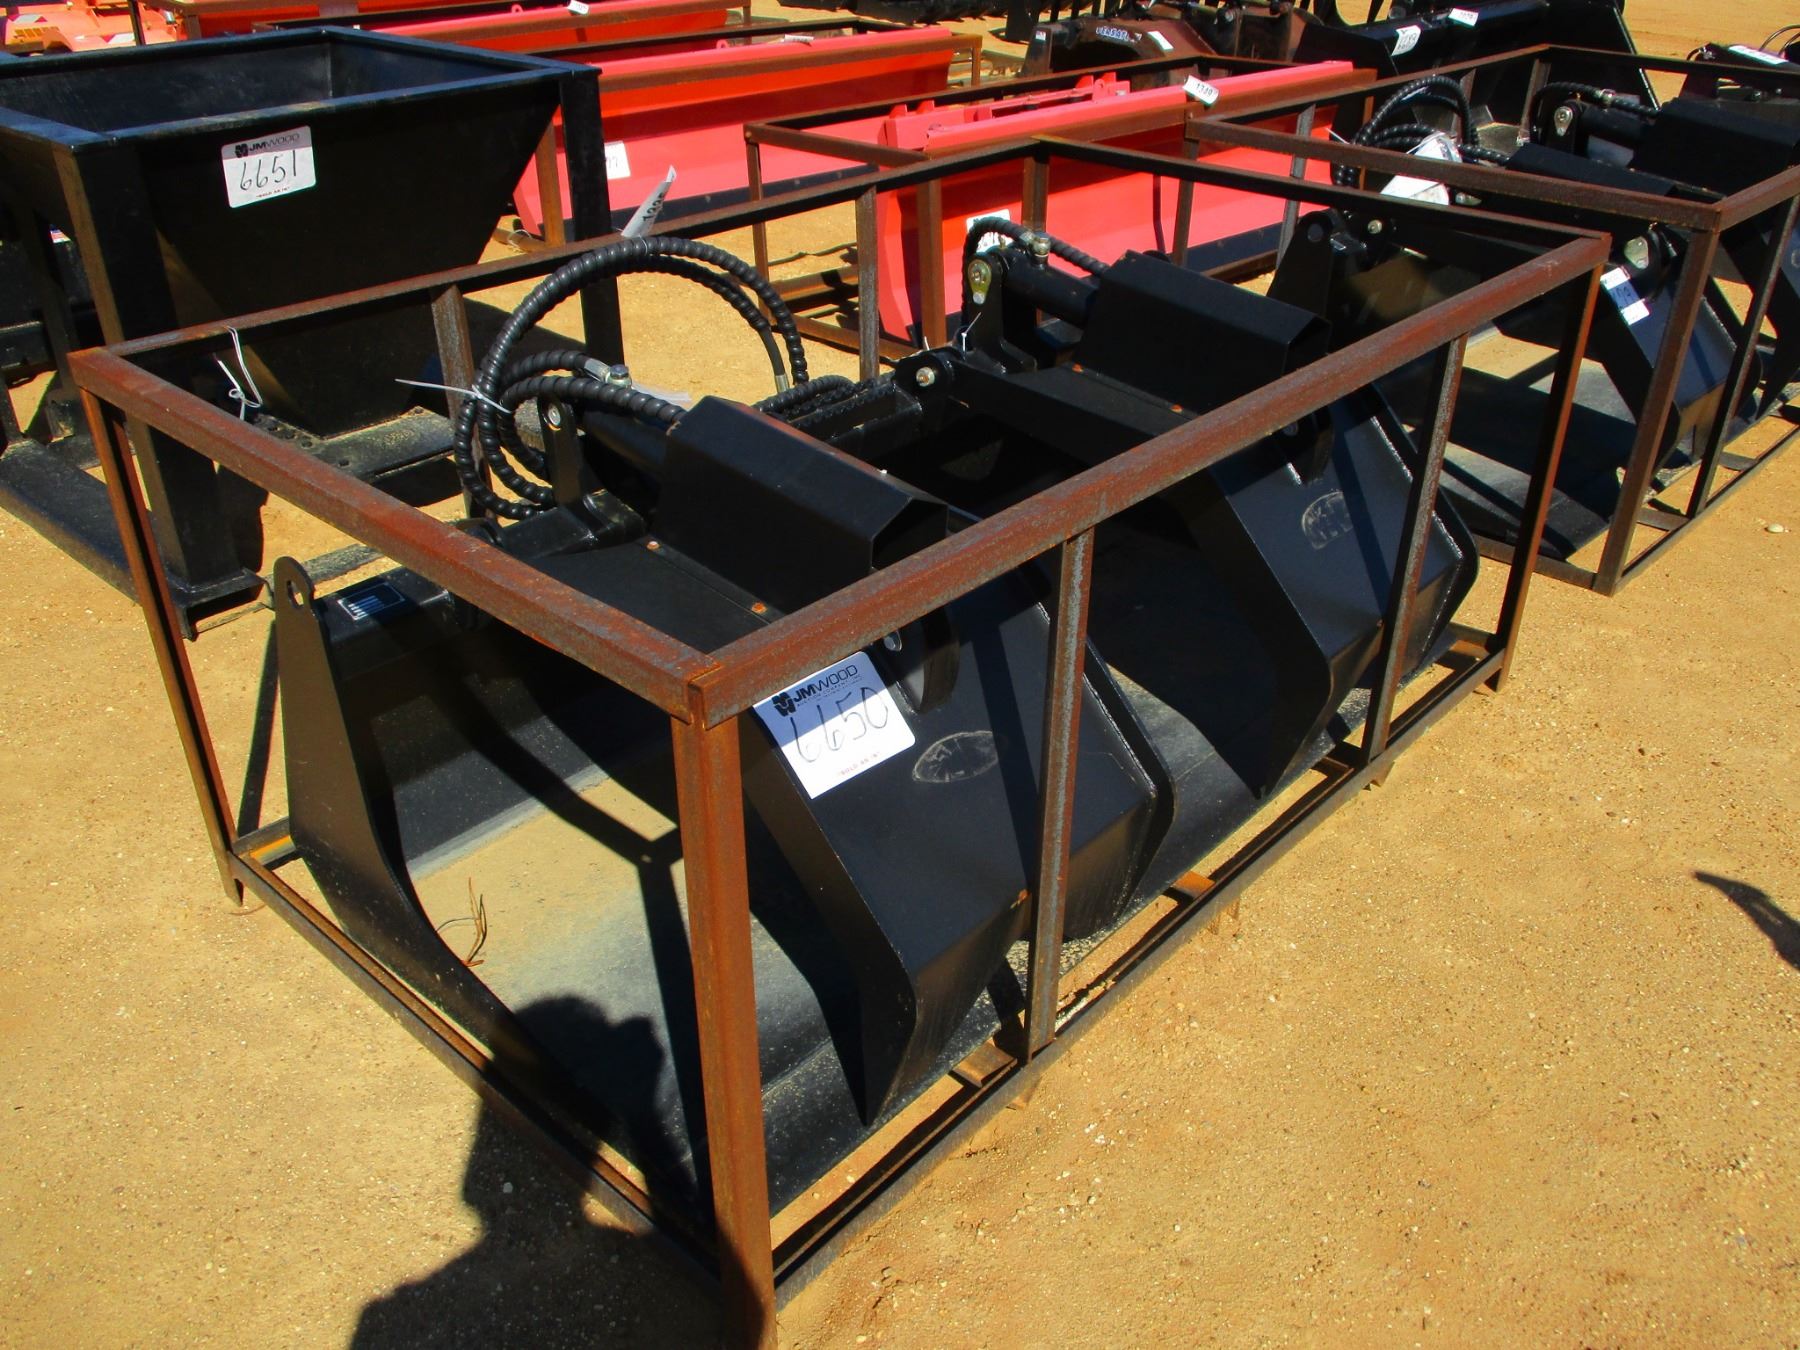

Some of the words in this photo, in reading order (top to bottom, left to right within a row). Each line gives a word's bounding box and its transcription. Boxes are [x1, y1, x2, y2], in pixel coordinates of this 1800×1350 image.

[249, 133, 299, 151] JMWOOD
[240, 149, 296, 190] 6651
[793, 664, 858, 702] JMWOOD
[791, 687, 888, 763] 6650
